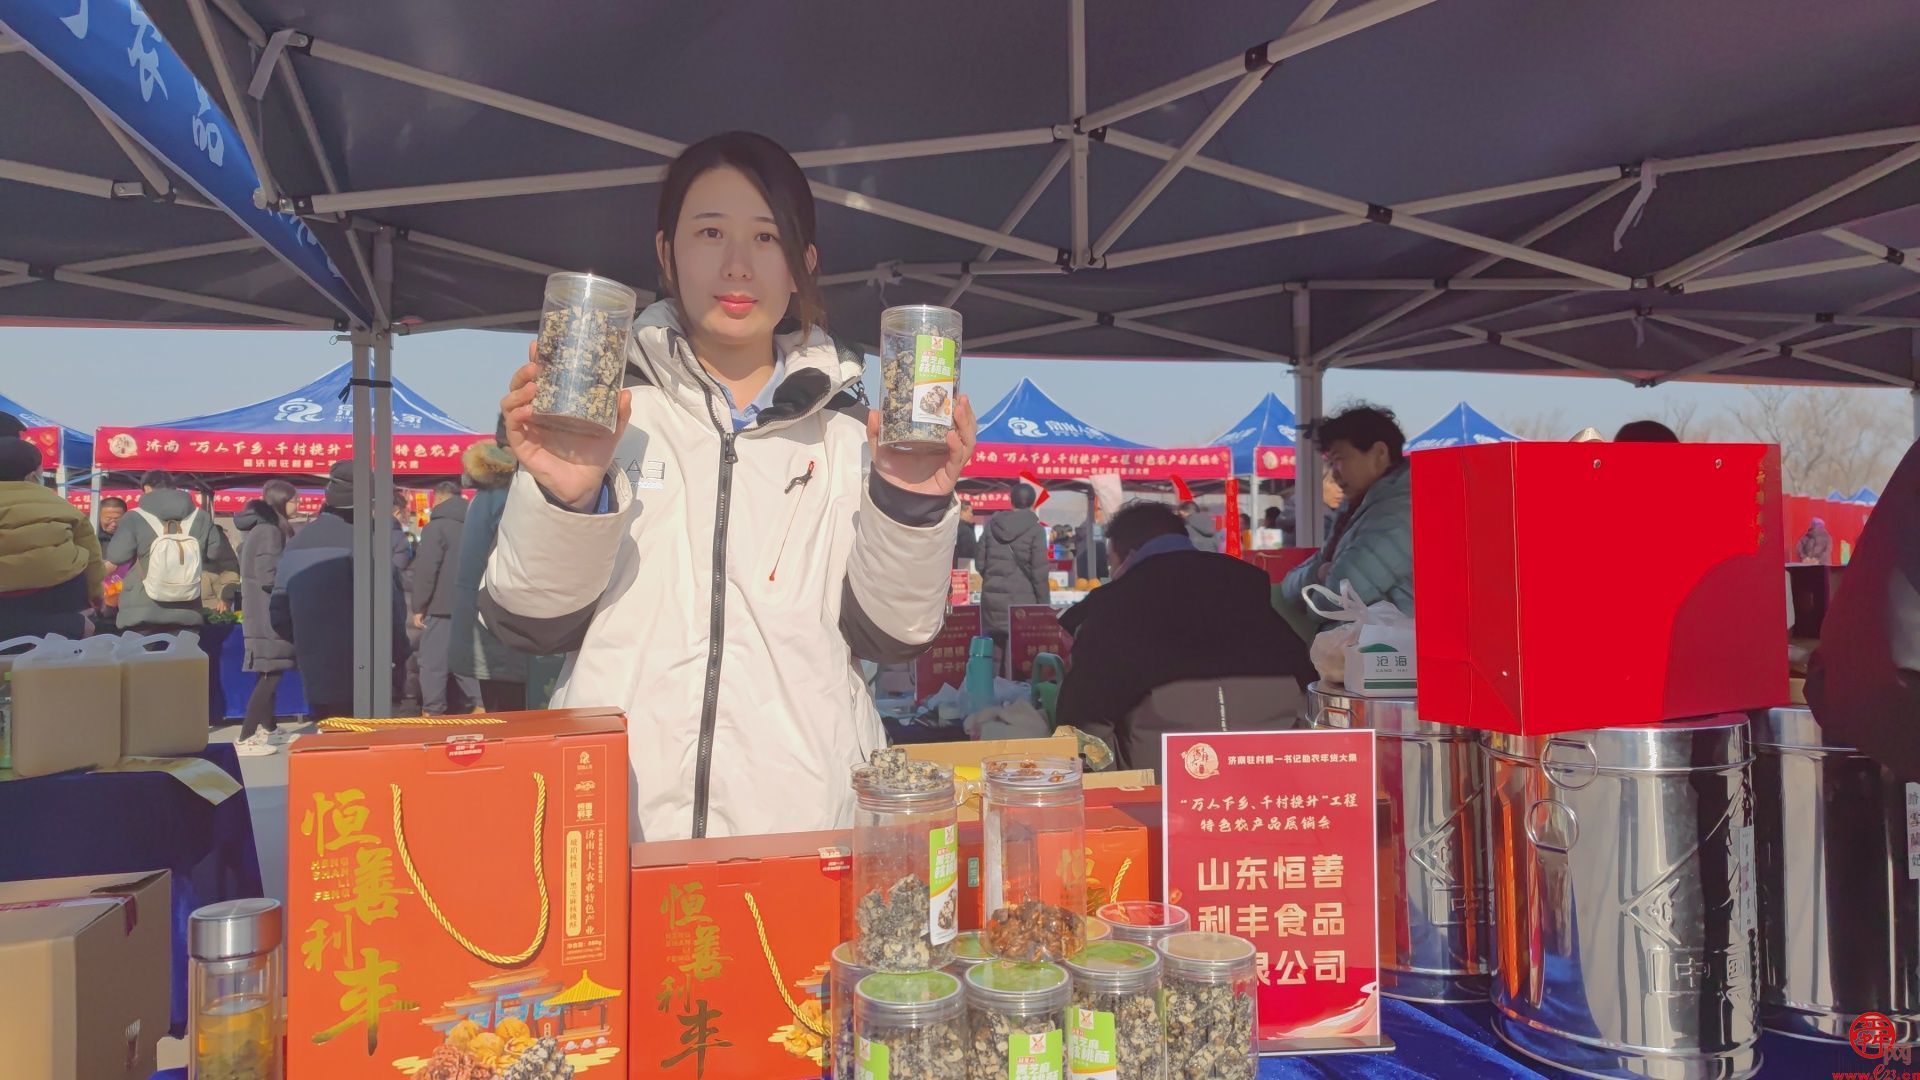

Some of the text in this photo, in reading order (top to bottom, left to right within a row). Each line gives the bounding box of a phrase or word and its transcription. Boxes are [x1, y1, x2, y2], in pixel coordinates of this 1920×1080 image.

[1227, 753, 1357, 766] 济南驻村第一书记助农年货大集
[1200, 815, 1332, 833] 特色农产品展销会
[1198, 854, 1345, 892] 山东恒善
[1198, 903, 1346, 939] 利丰食品
